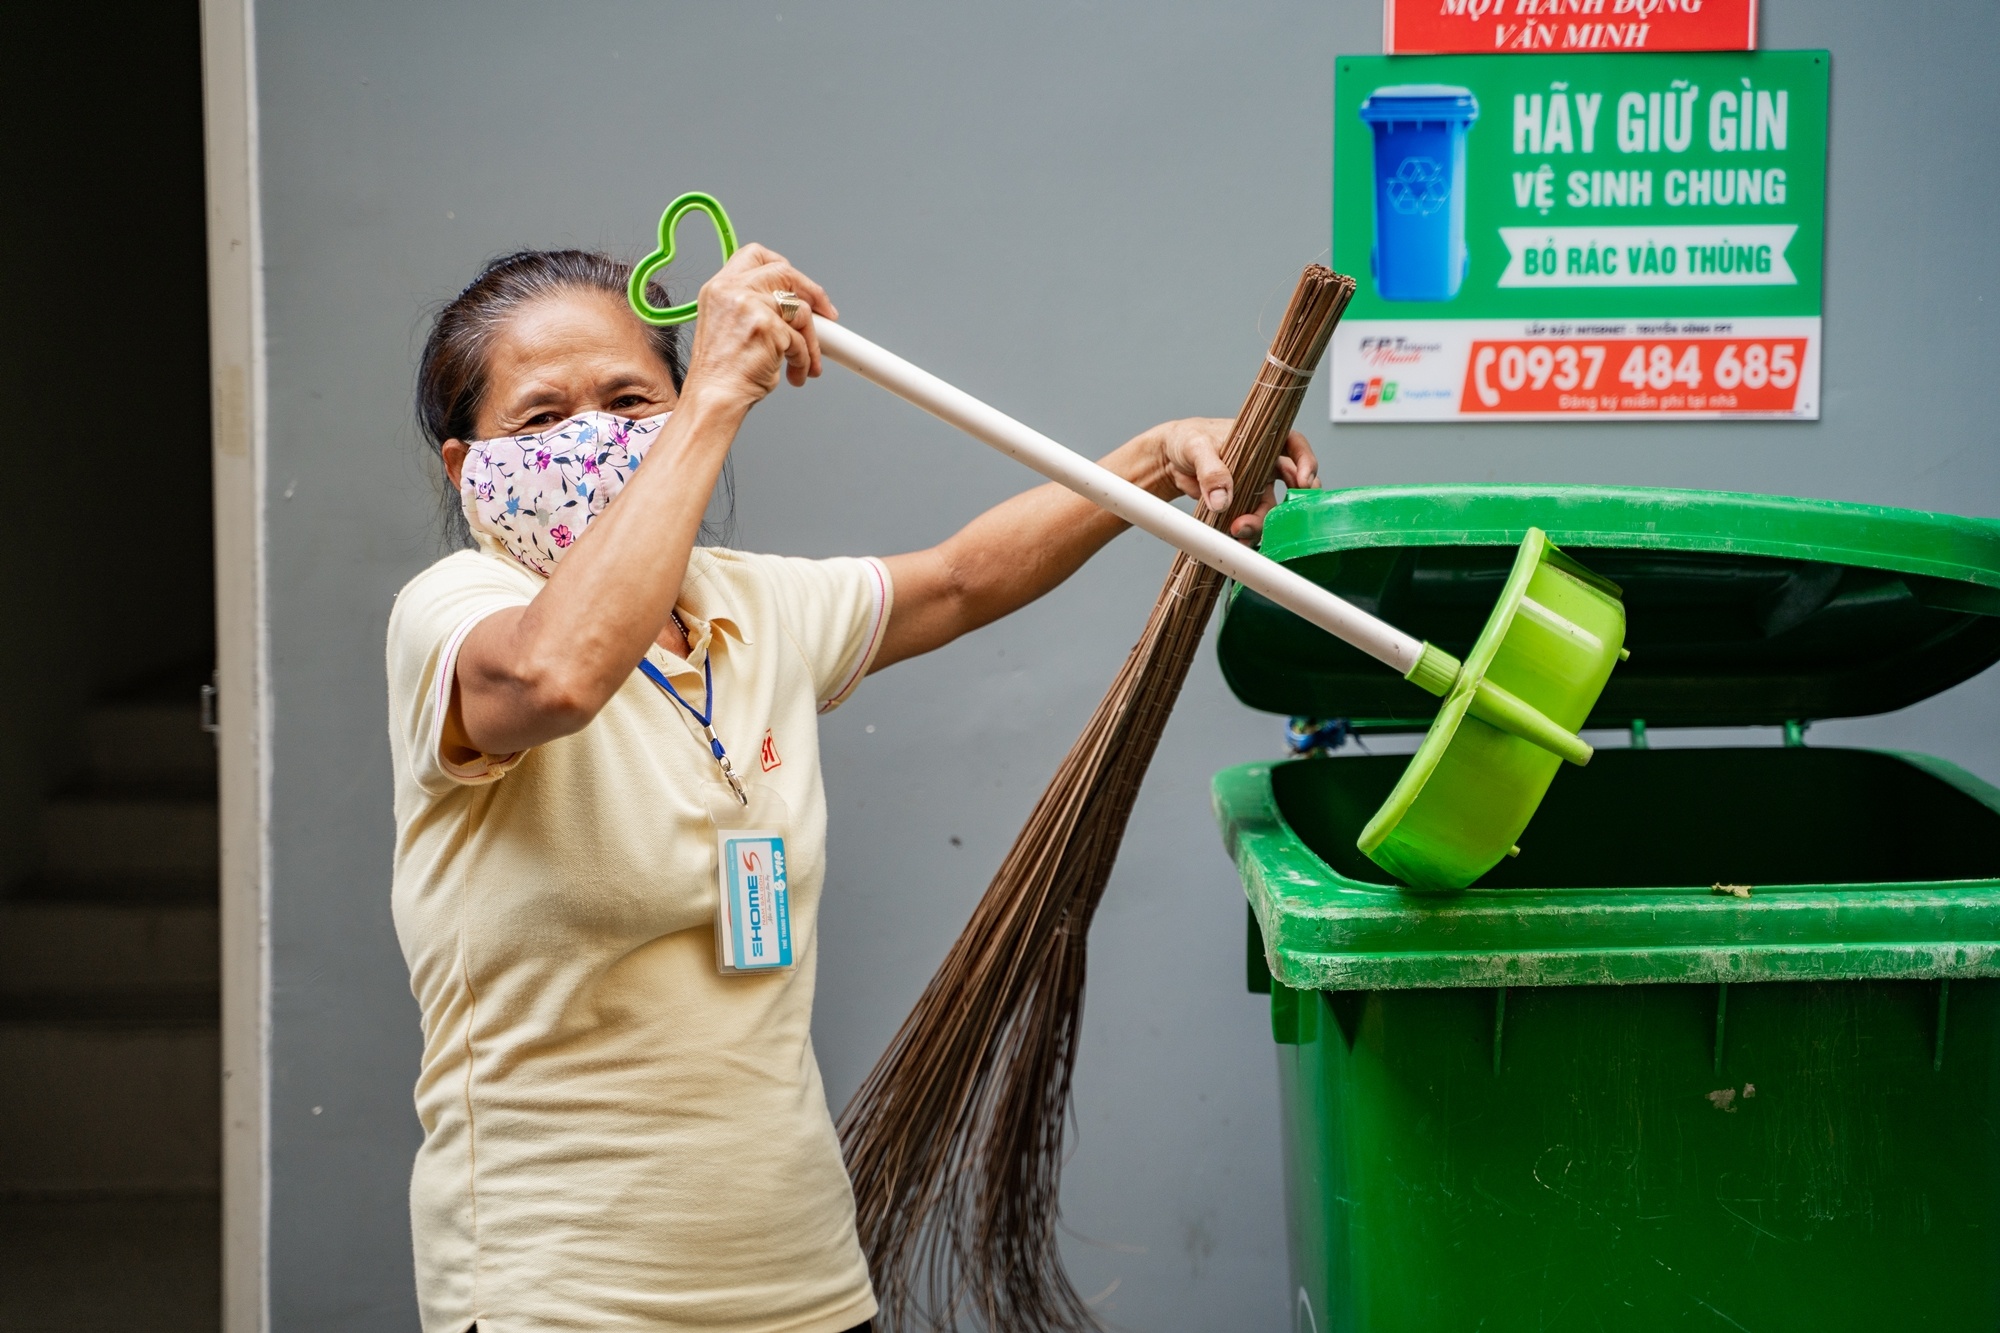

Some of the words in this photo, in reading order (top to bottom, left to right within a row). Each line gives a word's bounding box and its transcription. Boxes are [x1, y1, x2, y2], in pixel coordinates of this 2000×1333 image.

[1494, 18, 1558, 48] VĂN
[1561, 23, 1651, 48] MINH
[1512, 81, 1602, 154] HÃY
[1616, 79, 1699, 153] GIỮ
[1708, 77, 1788, 152] GÌN
[1512, 164, 1555, 215] VỆ
[1566, 170, 1653, 207] SINH
[1664, 168, 1787, 206] CHUNG
[1523, 236, 1558, 275] BỎ
[1566, 239, 1617, 275] RÁC
[1627, 239, 1677, 274] VÀO
[1686, 238, 1772, 274] THÙNG
[1360, 337, 1407, 351] FPT
[1498, 345, 1606, 391] 0937
[1619, 345, 1702, 390] 484
[1714, 344, 1798, 390] 685
[1349, 377, 1398, 407] FPT
[747, 875, 763, 957] EHOME
